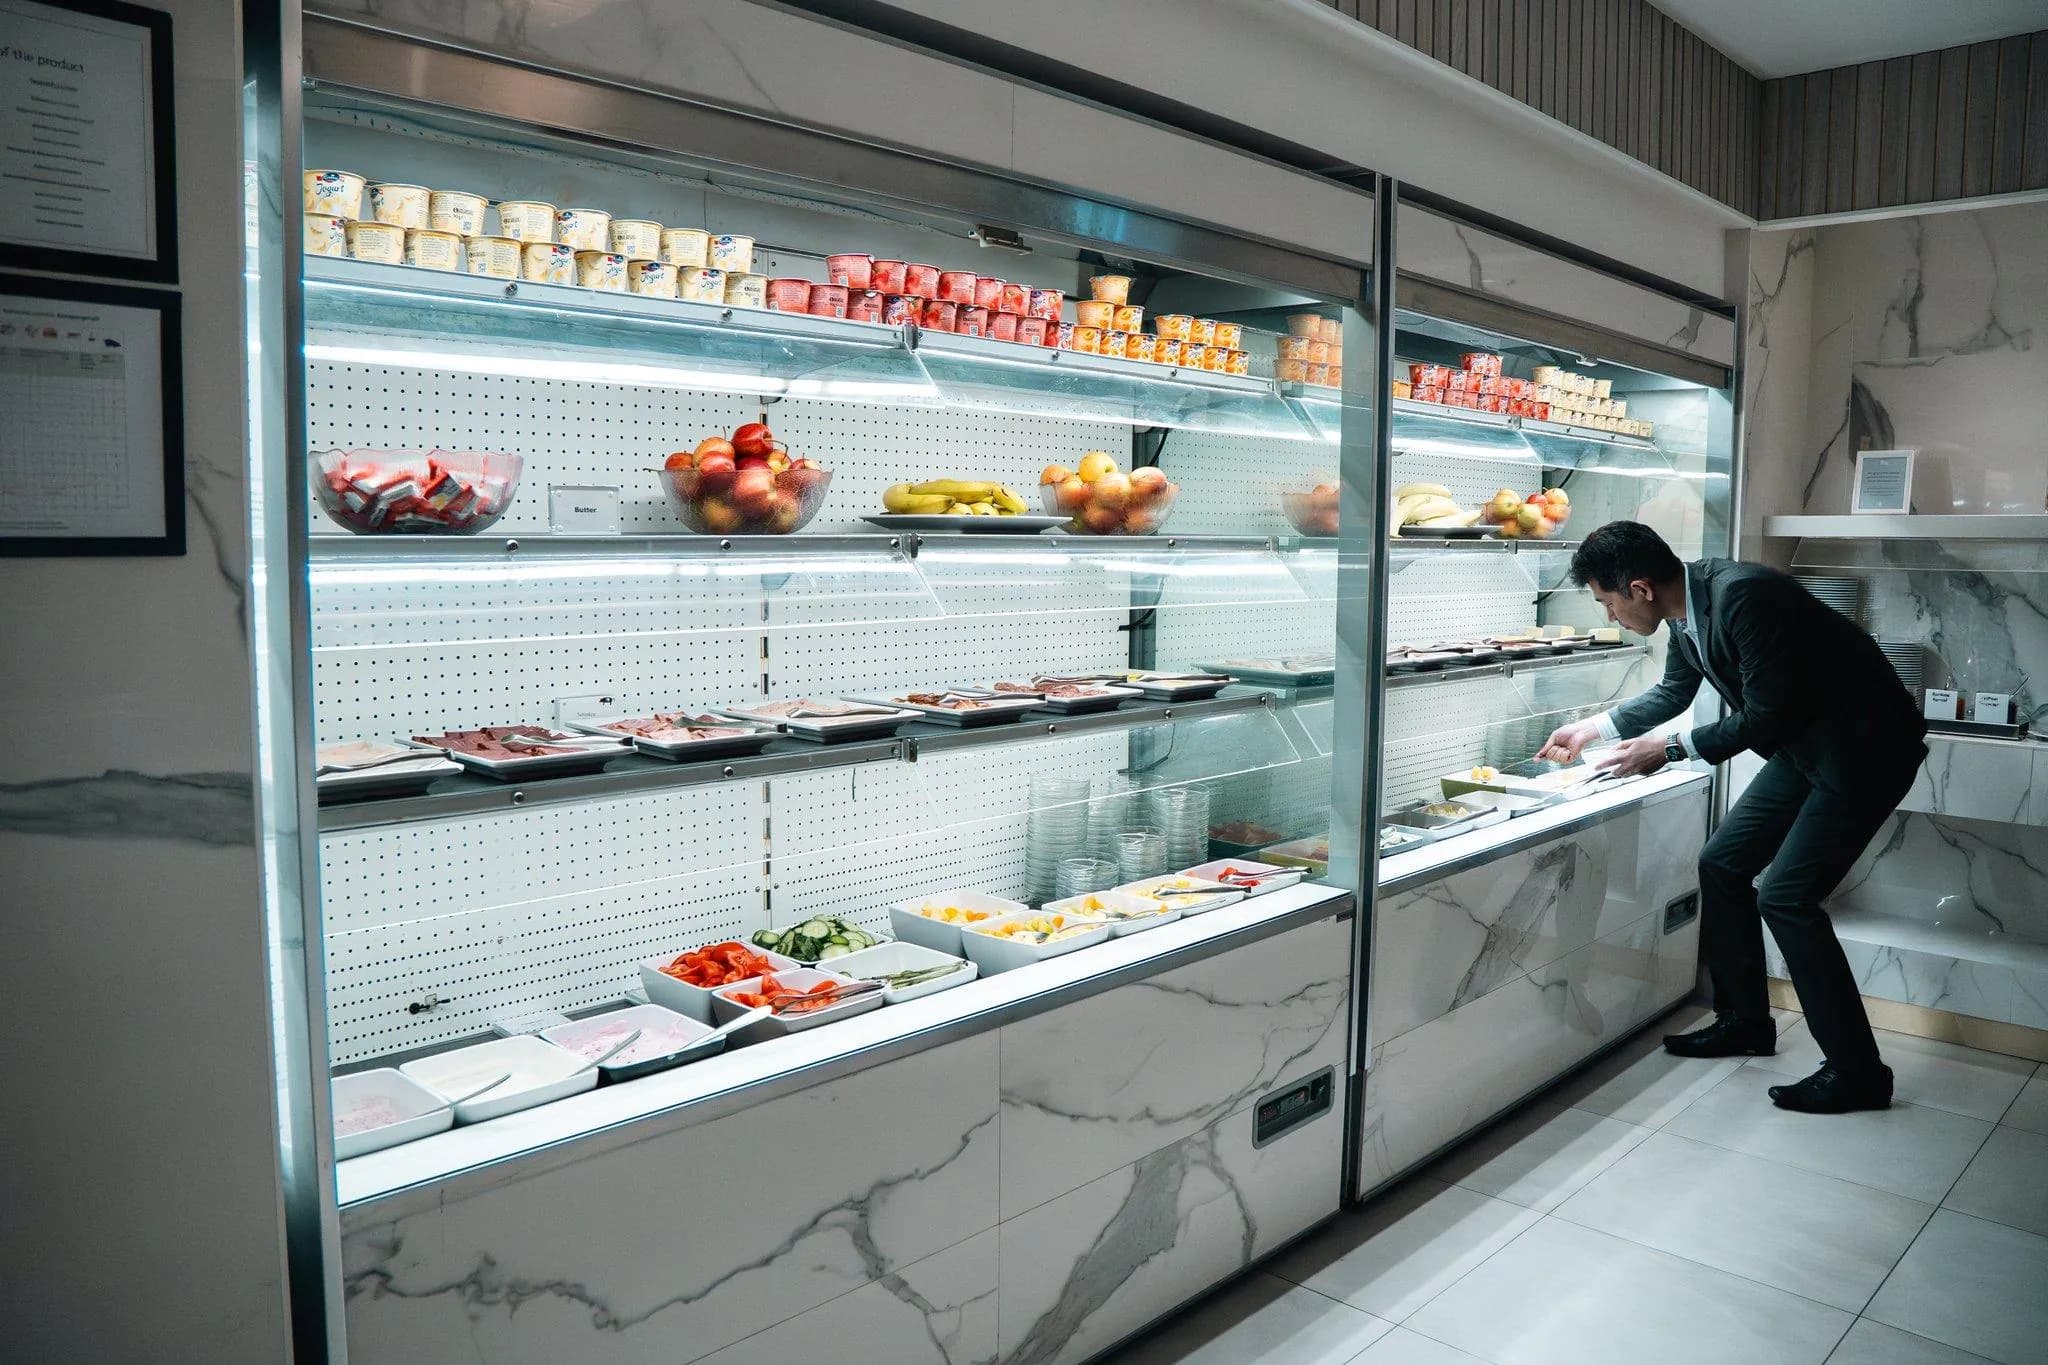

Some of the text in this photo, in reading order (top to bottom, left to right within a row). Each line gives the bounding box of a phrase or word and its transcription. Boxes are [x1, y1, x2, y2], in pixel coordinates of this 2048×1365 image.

[14, 49, 34, 62] the
[37, 55, 84, 73] product
[315, 183, 345, 197] Jogurt
